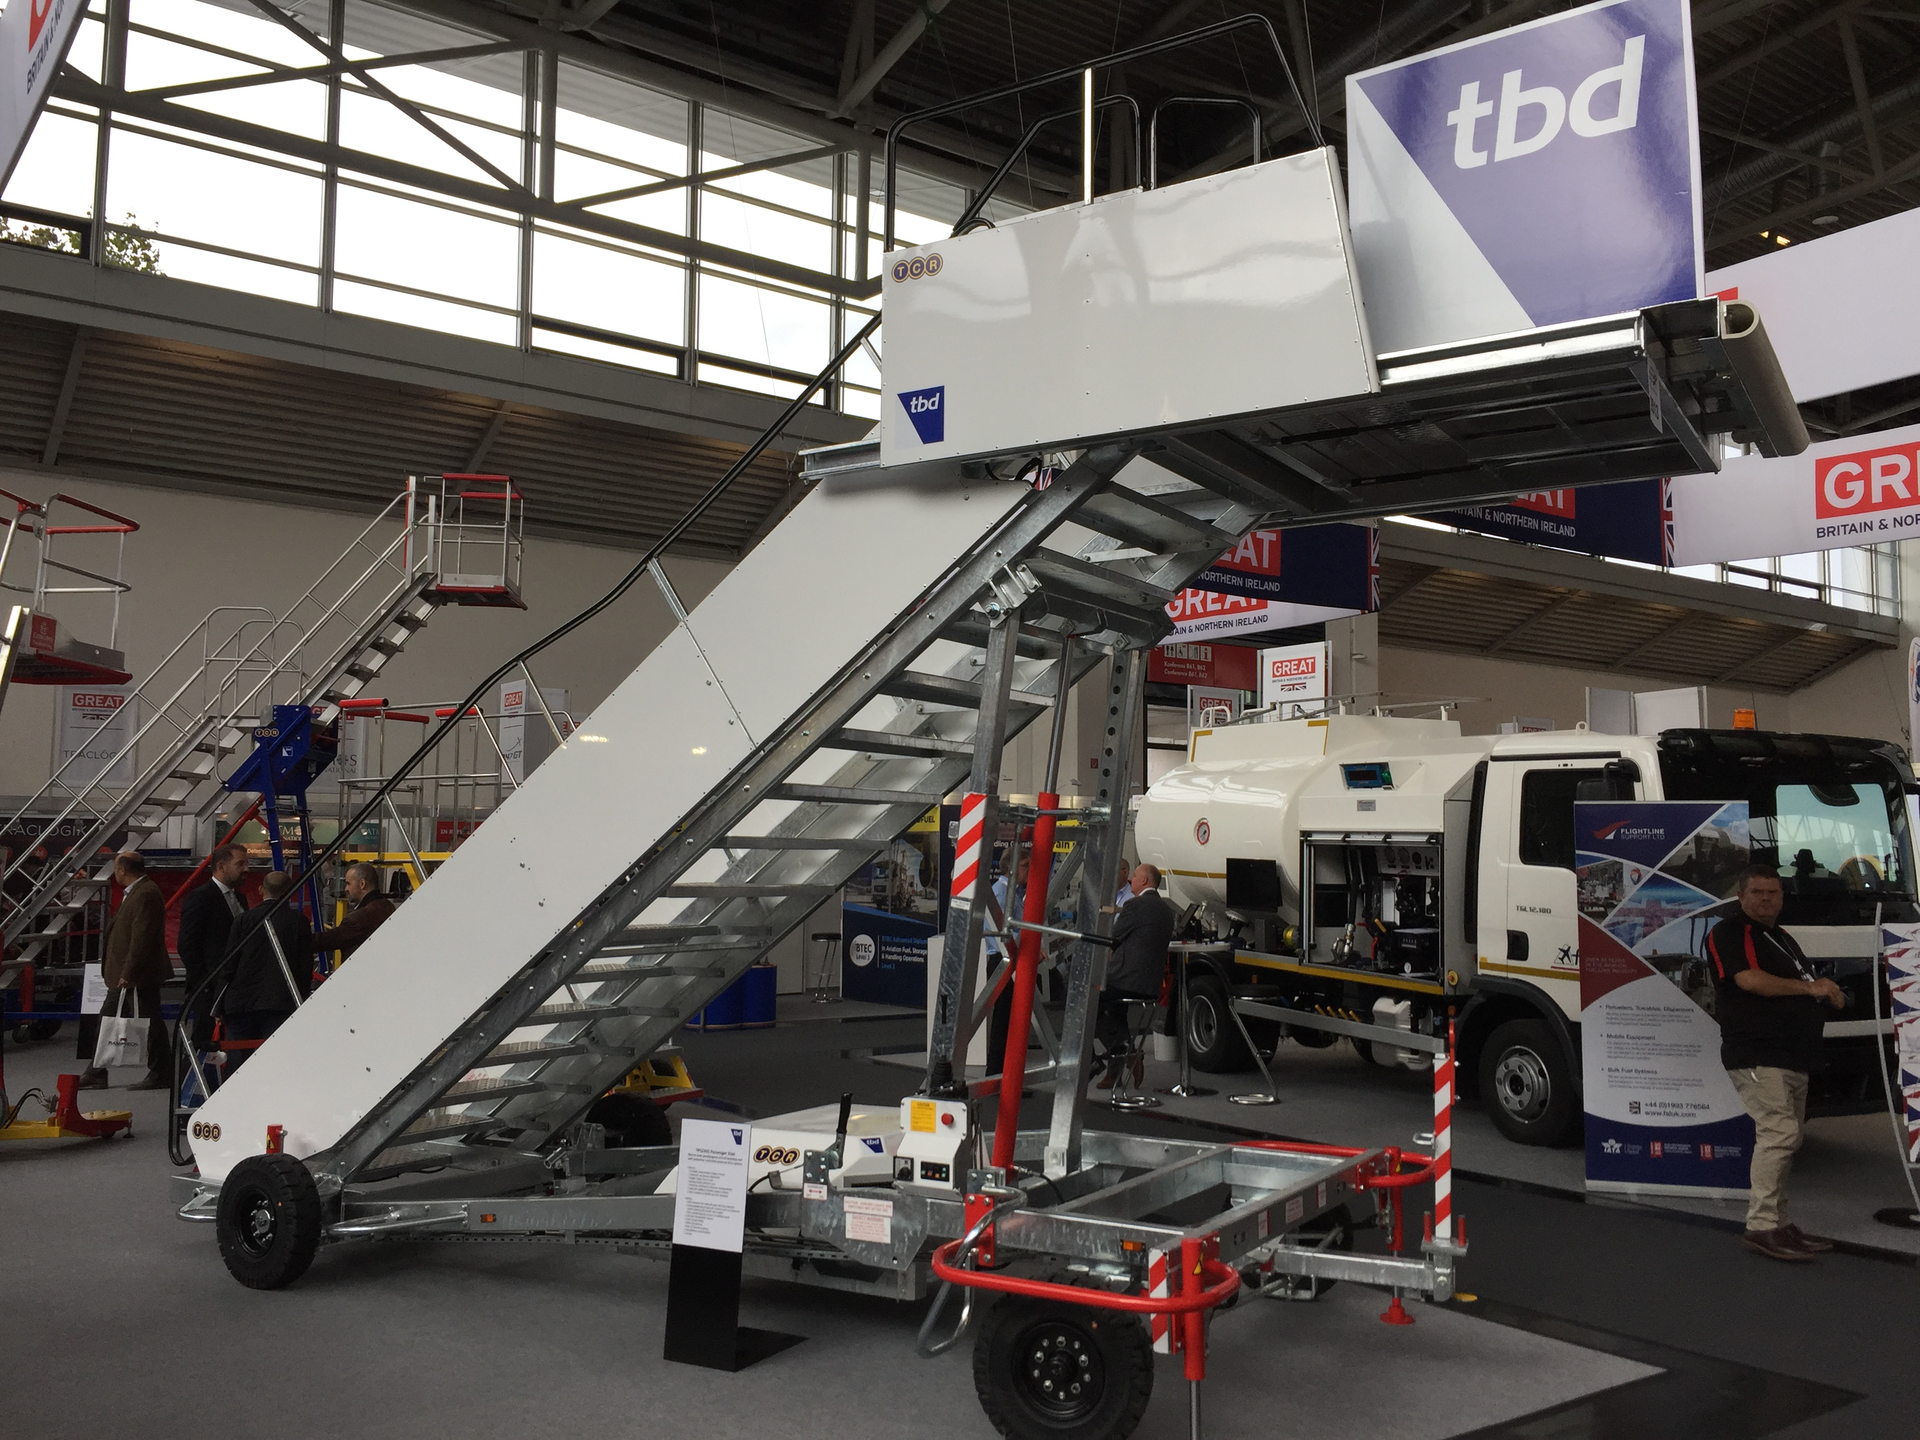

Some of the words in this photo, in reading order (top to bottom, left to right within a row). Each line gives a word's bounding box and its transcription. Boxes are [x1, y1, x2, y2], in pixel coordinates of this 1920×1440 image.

[27, 27, 49, 95] BRITAIN
[1446, 34, 1646, 169] tbd
[893, 255, 941, 281] TCR
[910, 392, 940, 414] tbd
[1484, 509, 1492, 521] &
[1492, 510, 1539, 531] NORTHERN
[1540, 520, 1577, 537] IRELAND
[1816, 520, 1874, 539] BRITAIN
[1878, 518, 1889, 531] &
[1245, 579, 1281, 592] IRELAND
[1188, 625, 1194, 634] &
[1194, 619, 1234, 633] NORTHERN
[1235, 614, 1269, 627] IRELAND
[1273, 658, 1315, 676] GREAT
[74, 694, 123, 708] GREAT
[504, 692, 523, 707] GREAT
[855, 943, 873, 954] BTEC
[856, 953, 867, 961] Level
[885, 953, 902, 962] Handling
[903, 954, 925, 963] Operations
[195, 1124, 220, 1139] TCR
[755, 1147, 799, 1164] TCR
